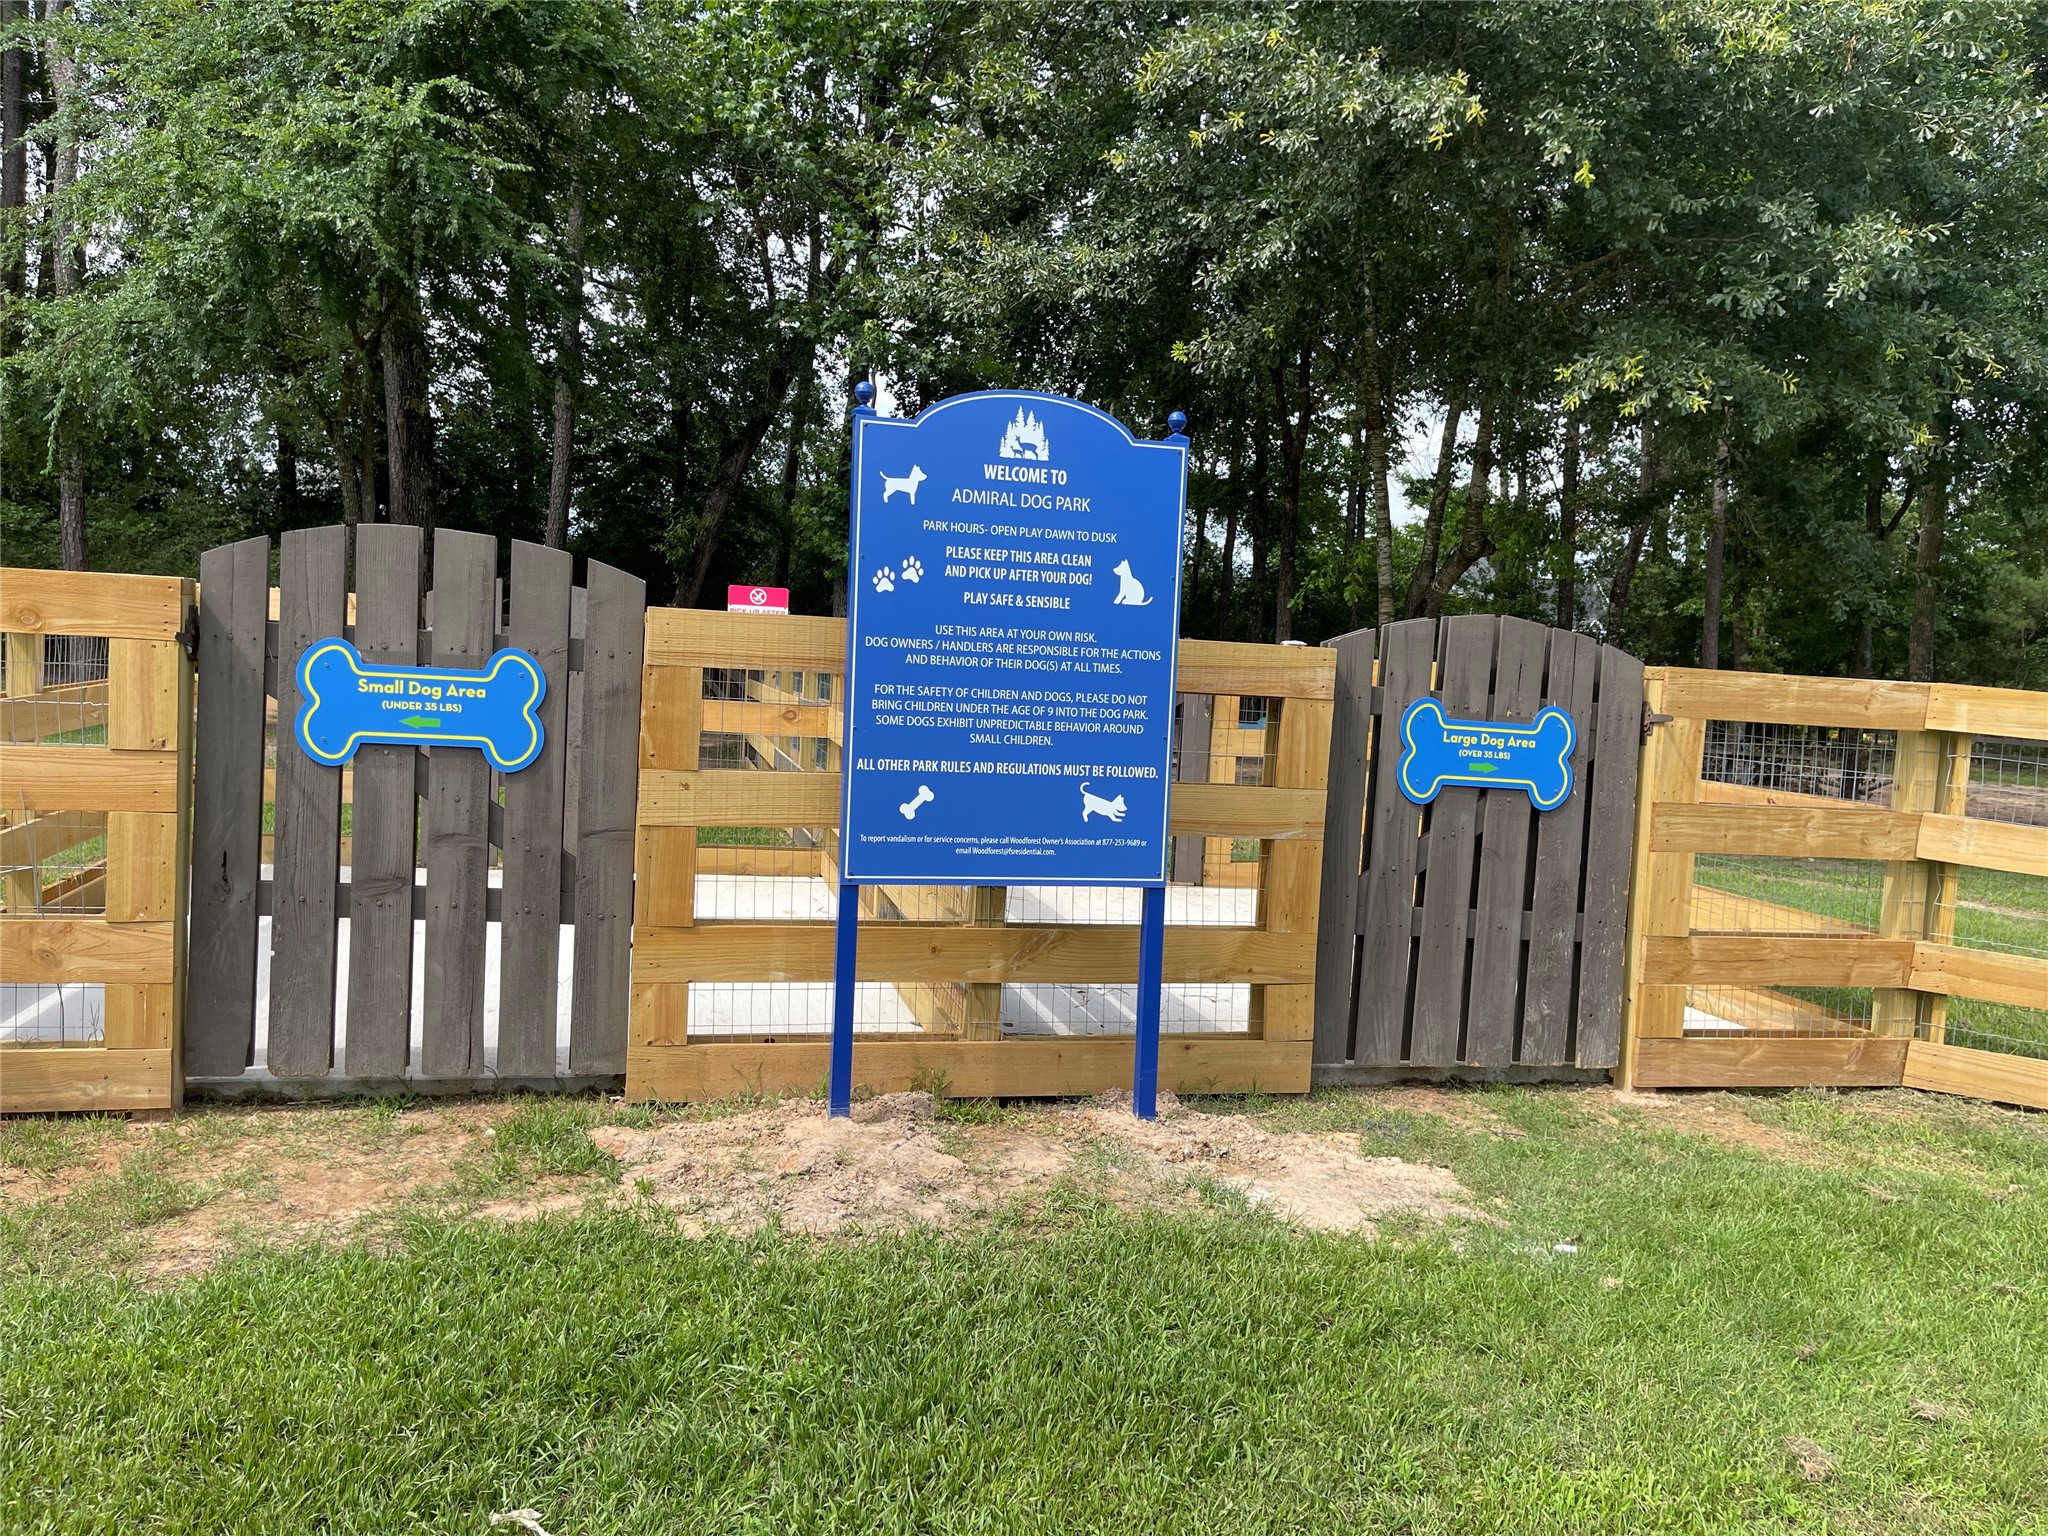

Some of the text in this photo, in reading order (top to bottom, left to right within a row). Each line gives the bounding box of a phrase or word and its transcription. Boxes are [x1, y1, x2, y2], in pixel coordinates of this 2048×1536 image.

[983, 463, 1067, 485] WELCOME TO
[951, 487, 1091, 513] ADMIRAL DOG PARK
[923, 519, 1117, 543] PARK HOURS- OPEN PLAY DAWN TO DUSK
[945, 545, 1092, 567] PLEASE KEEP THIS AREA CLEAN
[944, 564, 1093, 586] AND PICK UP AFTER YOUR DOG!
[963, 591, 1071, 610] PLAY SAFE & SENSIBLE
[934, 624, 1097, 643] USE THIS AREA AT YOUR OWN RISK.
[864, 635, 888, 648] DOG
[889, 636, 934, 650] OWNERS
[941, 639, 994, 653] HANDLERS
[995, 642, 1014, 654] ARE
[1016, 643, 1079, 657] RESPONSIBLE
[1080, 646, 1100, 658] FOR
[1100, 647, 1119, 659] THE
[1120, 648, 1161, 661] ACTIONS
[904, 653, 1123, 674] AND BEHAVIOR OF THEIR DOG(S) AT ALL TIMES.
[357, 678, 487, 700] Small Dog Area
[874, 683, 1148, 705] FOR THE SAFETY OF CHILDREN AND DOGS, PLEASE DO NOT
[381, 700, 463, 714] (UNDER 35 LBS)
[871, 698, 1149, 720] BRING CHILDREN UNDER THE AGE OF 9 INTO THE DOG PARK.
[875, 714, 1144, 735] SOME DOGS EXHIBIT UNPREDICTABLE BEHAVIOR AROUND
[969, 732, 1054, 746] SMALL CHILDREN.
[1443, 731, 1536, 749] Large Dog Area
[1458, 749, 1511, 760] (OVER 35 LBS)
[856, 757, 1159, 779] ALL OTHER PARK RULES AND REGULATIONS MUST BE FOLLOWED.
[859, 833, 867, 842] To
[867, 835, 886, 844] report
[886, 834, 917, 843] vandalism
[923, 834, 933, 843] for
[932, 835, 953, 844] service
[953, 836, 980, 844] concerns,
[980, 835, 999, 845] please
[998, 836, 1010, 844] call
[1009, 836, 1042, 845] Woodforest
[1064, 837, 1095, 846] Association
[1095, 838, 1102, 846] at
[1101, 838, 1141, 847] 877-253-9689
[955, 846, 972, 855] email
